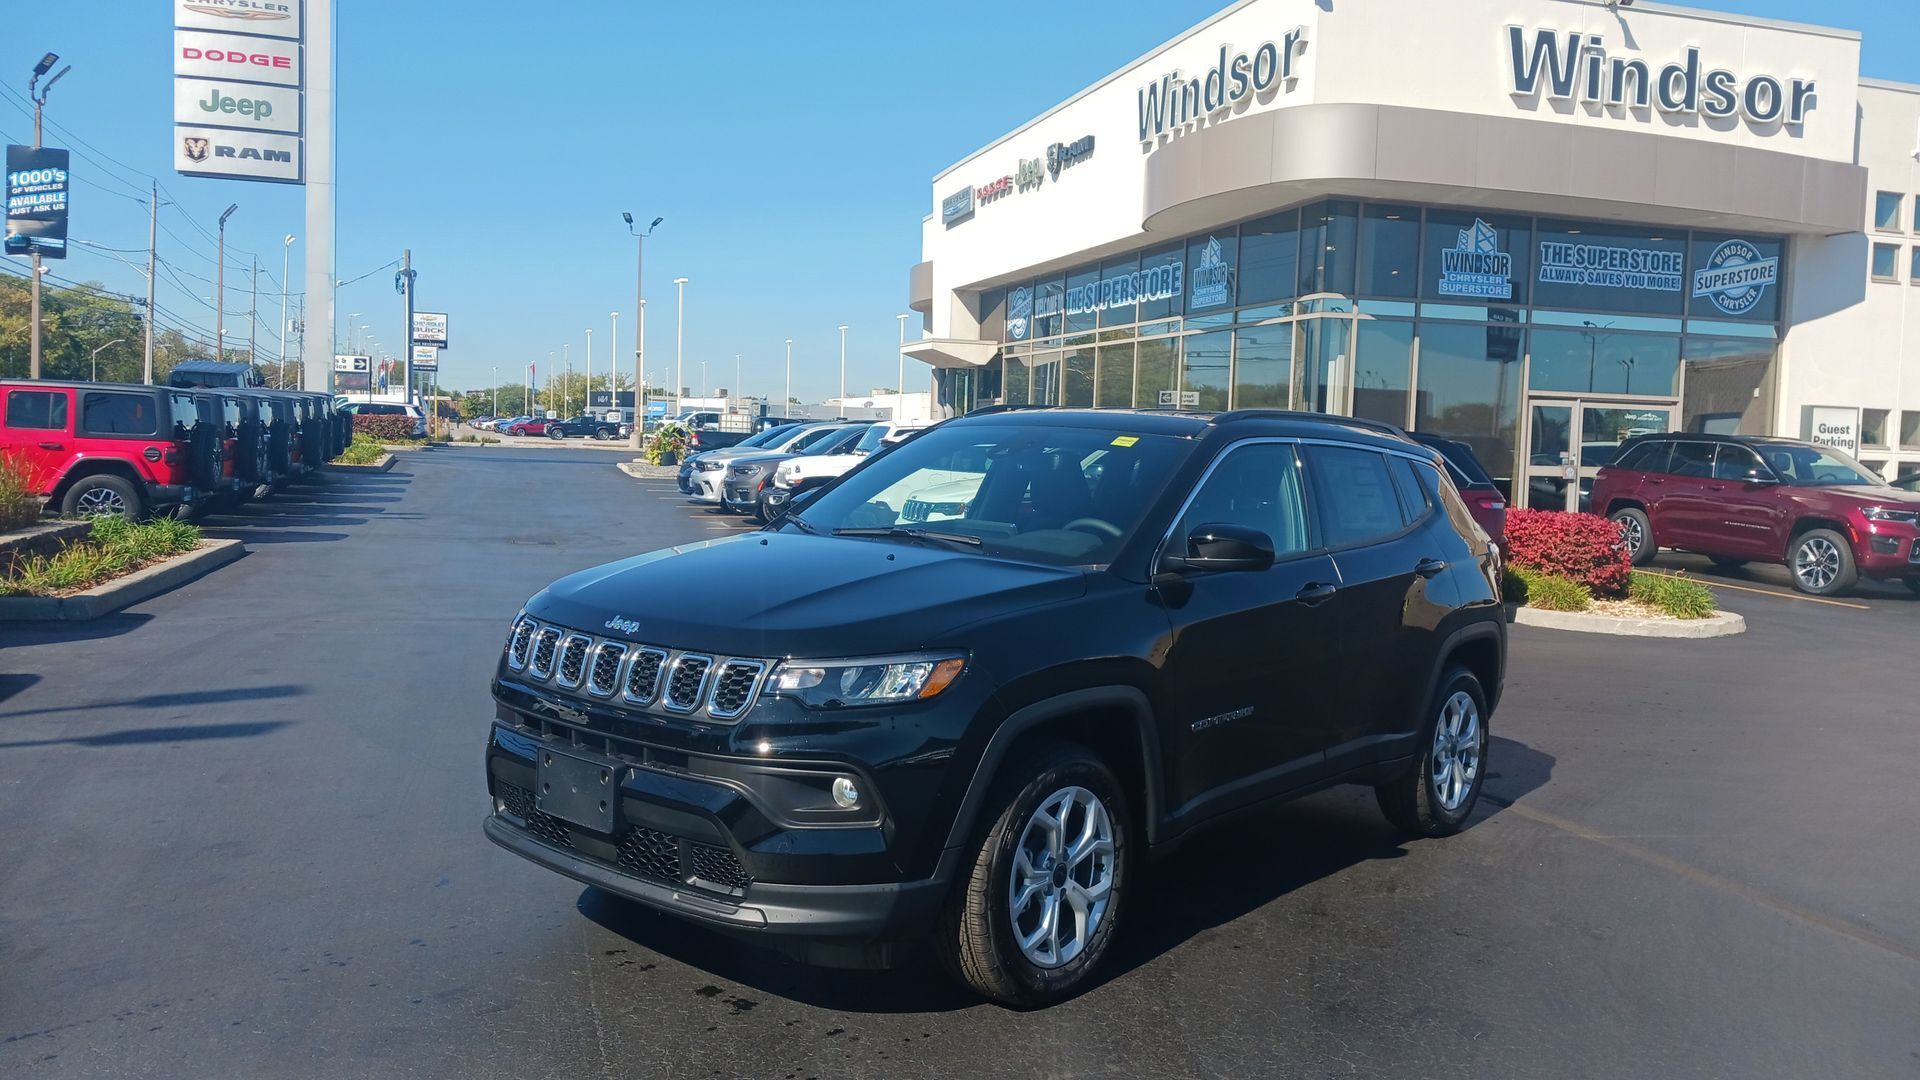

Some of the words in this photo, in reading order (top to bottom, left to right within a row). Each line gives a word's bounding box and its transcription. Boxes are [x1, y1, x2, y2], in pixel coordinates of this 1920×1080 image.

[186, 0, 290, 12] HRYSLER
[183, 47, 291, 69] DODGE
[1507, 24, 1817, 124] Windsor
[1138, 26, 1306, 144] Windsor
[199, 88, 273, 121] Jeep
[214, 145, 291, 163] RAM
[1015, 157, 1046, 190] Jeep
[12, 186, 23, 194] OF
[24, 183, 63, 193] VEHICLES
[9, 193, 66, 207] AVAILABLE
[9, 206, 31, 216] JUST
[33, 204, 51, 213] ASK
[53, 203, 66, 211] US
[1444, 251, 1509, 276] WINDSOR
[1542, 243, 1573, 265] THE
[1576, 246, 1682, 273] SUPERSTORE
[1714, 245, 1753, 265] WINDSOR
[1066, 288, 1083, 314] THE
[1084, 262, 1182, 313] SUPERSTORE
[1449, 273, 1502, 285] CHRYSLER
[1541, 267, 1586, 284] ALWAYS
[1587, 270, 1622, 286] SAVES
[1623, 273, 1645, 287] YOU
[1647, 275, 1681, 290] MORE!
[1697, 265, 1774, 291] SUPERSTORE
[1441, 283, 1509, 296] SUPERSTORE
[1719, 288, 1757, 309] CHRYSLER
[1818, 423, 1850, 435] Guest
[1813, 435, 1855, 449] Parking
[604, 614, 641, 635] Jeep
